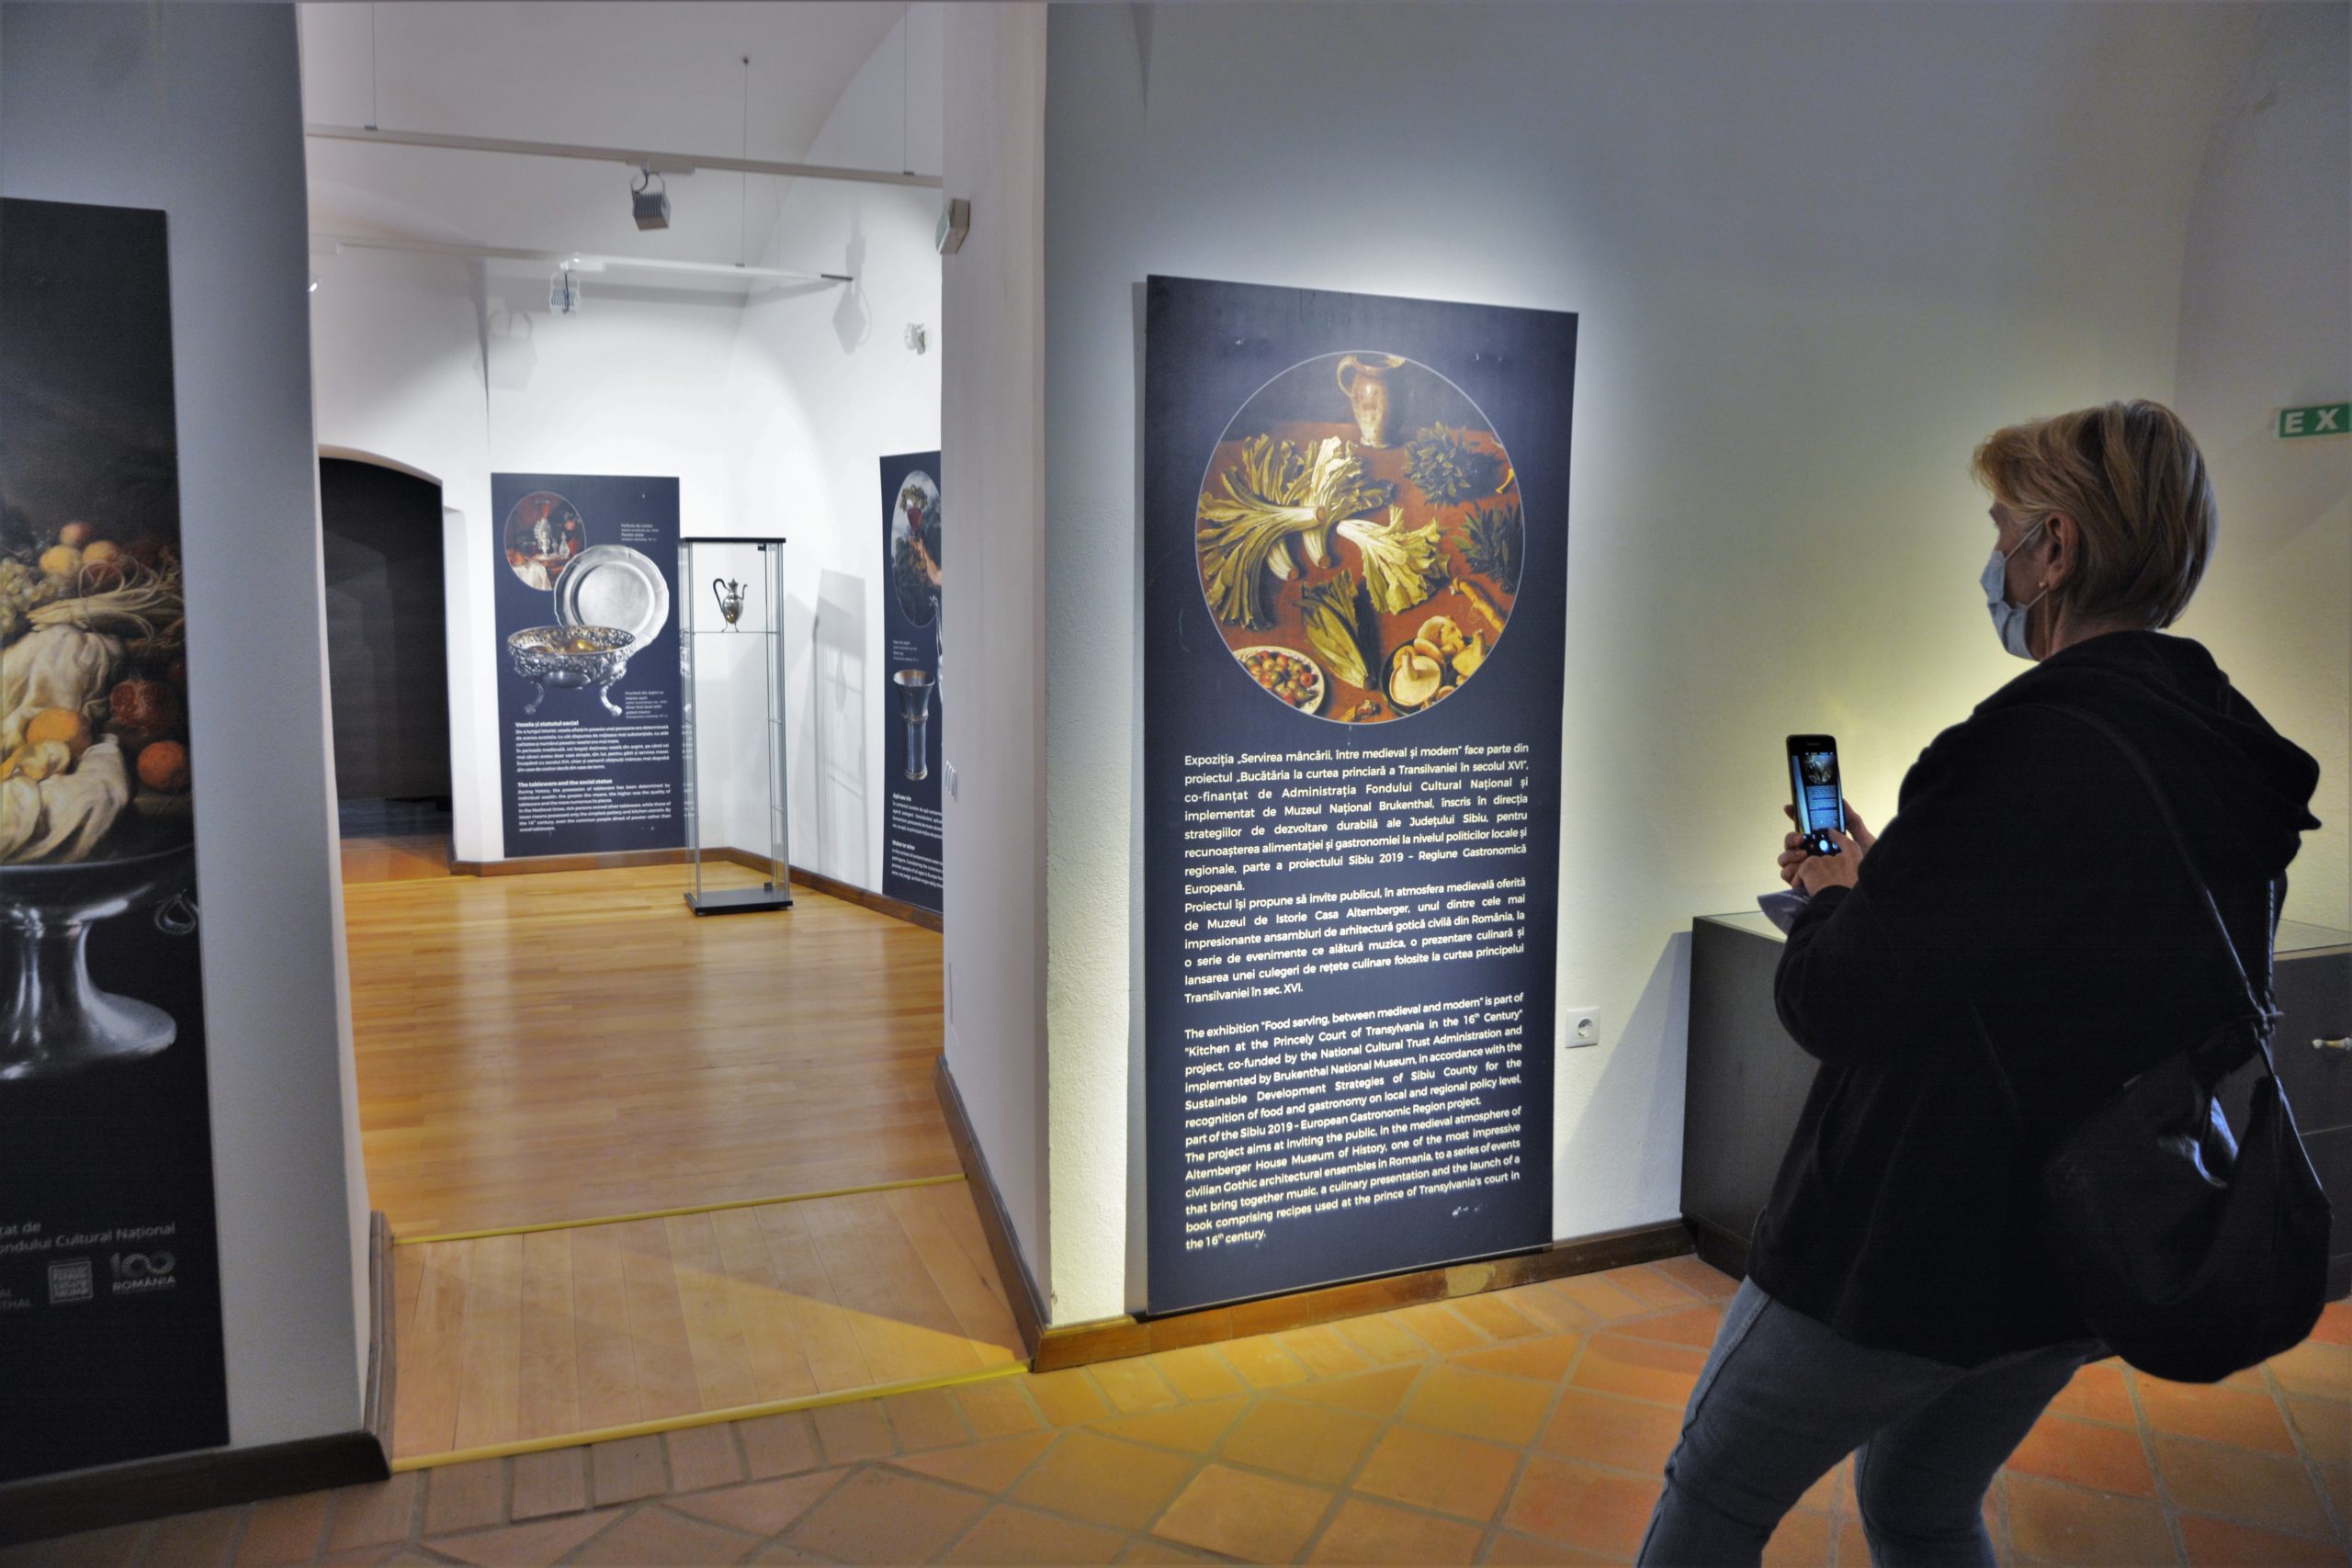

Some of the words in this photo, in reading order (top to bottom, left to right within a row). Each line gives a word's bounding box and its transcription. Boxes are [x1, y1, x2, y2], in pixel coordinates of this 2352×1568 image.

[1184, 753, 1234, 767] Expoziția
[1335, 749, 1360, 760] între
[1362, 747, 1407, 759] medieval
[1409, 746, 1418, 760] și
[1464, 744, 1485, 755] face
[1487, 744, 1511, 756] parte
[1513, 742, 1529, 753] din
[1184, 772, 1232, 786] proiectul
[1294, 769, 1303, 779] la
[1306, 768, 1339, 779] curtea
[1341, 765, 1385, 779] princiară
[1388, 767, 1396, 775] a
[1397, 762, 1457, 774] Transilvaniei
[1460, 761, 1470, 772] în
[1472, 761, 1505, 772] secolul
[1183, 790, 1248, 803] co-finanțat
[1257, 788, 1272, 799] de
[1281, 784, 1356, 798] Administrația
[1365, 781, 1412, 794] Fondului
[1420, 779, 1462, 791] Cultural
[1470, 777, 1512, 791] Național
[1520, 776, 1528, 789] și
[1184, 807, 1255, 823] implementat
[1262, 806, 1276, 817] de
[1284, 804, 1321, 816] Muzeul
[1329, 801, 1372, 815] Național
[1378, 797, 1434, 811] Brukenthal,
[1441, 795, 1471, 807] înscris
[1476, 795, 1487, 806] în
[1492, 793, 1528, 806] direcția
[1184, 826, 1242, 840] strategiilor
[1250, 825, 1265, 836] de
[1273, 822, 1328, 834] dezvoltare
[1336, 818, 1378, 830] durabilă
[1385, 817, 1401, 828] ale
[1408, 814, 1454, 828] Județului
[1462, 812, 1488, 823] Sibiu,
[1496, 811, 1527, 823] pentru
[1184, 845, 1260, 858] recunoașterea
[1261, 839, 1323, 853] alimentației
[1325, 838, 1333, 852] și
[1335, 834, 1400, 851] gastronomiei
[1402, 834, 1411, 844] la
[1412, 831, 1444, 843] nivelul
[1445, 829, 1490, 843] politicilor
[1491, 828, 1519, 839] locale
[1519, 826, 1527, 839] și
[1184, 863, 1237, 878] regionale,
[1242, 862, 1271, 874] parte
[1275, 862, 1283, 870] a
[1288, 855, 1343, 872] proiectului
[1348, 853, 1374, 865] Sibiu
[1378, 852, 1404, 863] 2019
[1418, 849, 1458, 862] Regiune
[1462, 843, 1527, 857] Gastronomică
[1183, 1028, 1204, 1039] The
[1206, 1022, 1259, 1037] exhibition
[1292, 1015, 1330, 1028] serving,
[1331, 1010, 1375, 1023] between
[1376, 1003, 1420, 1018] medieval
[1422, 1000, 1441, 1013] and
[1485, 996, 1492, 1006] is
[1493, 994, 1512, 1007] part
[1513, 991, 1524, 1002] of
[1235, 1041, 1246, 1052] at
[1250, 1038, 1268, 1050] the
[1273, 1032, 1314, 1047] Princely
[1317, 1030, 1346, 1042] Court
[1351, 1026, 1362, 1038] of
[1364, 1020, 1424, 1036] Transylvania
[1429, 1019, 1439, 1029] in
[1442, 1016, 1459, 1027] the
[1184, 1061, 1225, 1077] project,
[1227, 1053, 1281, 1070] co-funded
[1284, 1053, 1297, 1065] by
[1299, 1050, 1317, 1062] the
[1320, 1043, 1362, 1059] National
[1364, 1039, 1403, 1054] Cultural
[1406, 1036, 1430, 1048] Trust
[1432, 1028, 1502, 1045] Administration
[1504, 1024, 1522, 1036] and
[1184, 1074, 1257, 1093] implemented
[1258, 1073, 1272, 1086] by
[1272, 1065, 1329, 1082] Brukenthal
[1330, 1059, 1372, 1075] National
[1374, 1056, 1418, 1069] Museum,
[1419, 1053, 1428, 1064] in
[1429, 1047, 1484, 1062] accordance
[1484, 1043, 1505, 1055] with
[1506, 1042, 1522, 1053] the
[1184, 1093, 1248, 1111] Sustainable
[1256, 1083, 1326, 1101] Development
[1334, 1076, 1385, 1091] Strategies
[1392, 1072, 1403, 1084] of
[1410, 1068, 1435, 1081] Sibiu
[1442, 1064, 1477, 1077] County
[1485, 1061, 1498, 1071] for
[1506, 1057, 1521, 1068] the
[55, 1230, 112, 1247] Cultural
[1185, 1238, 1204, 1250] the
[1225, 1229, 1266, 1244] century.
